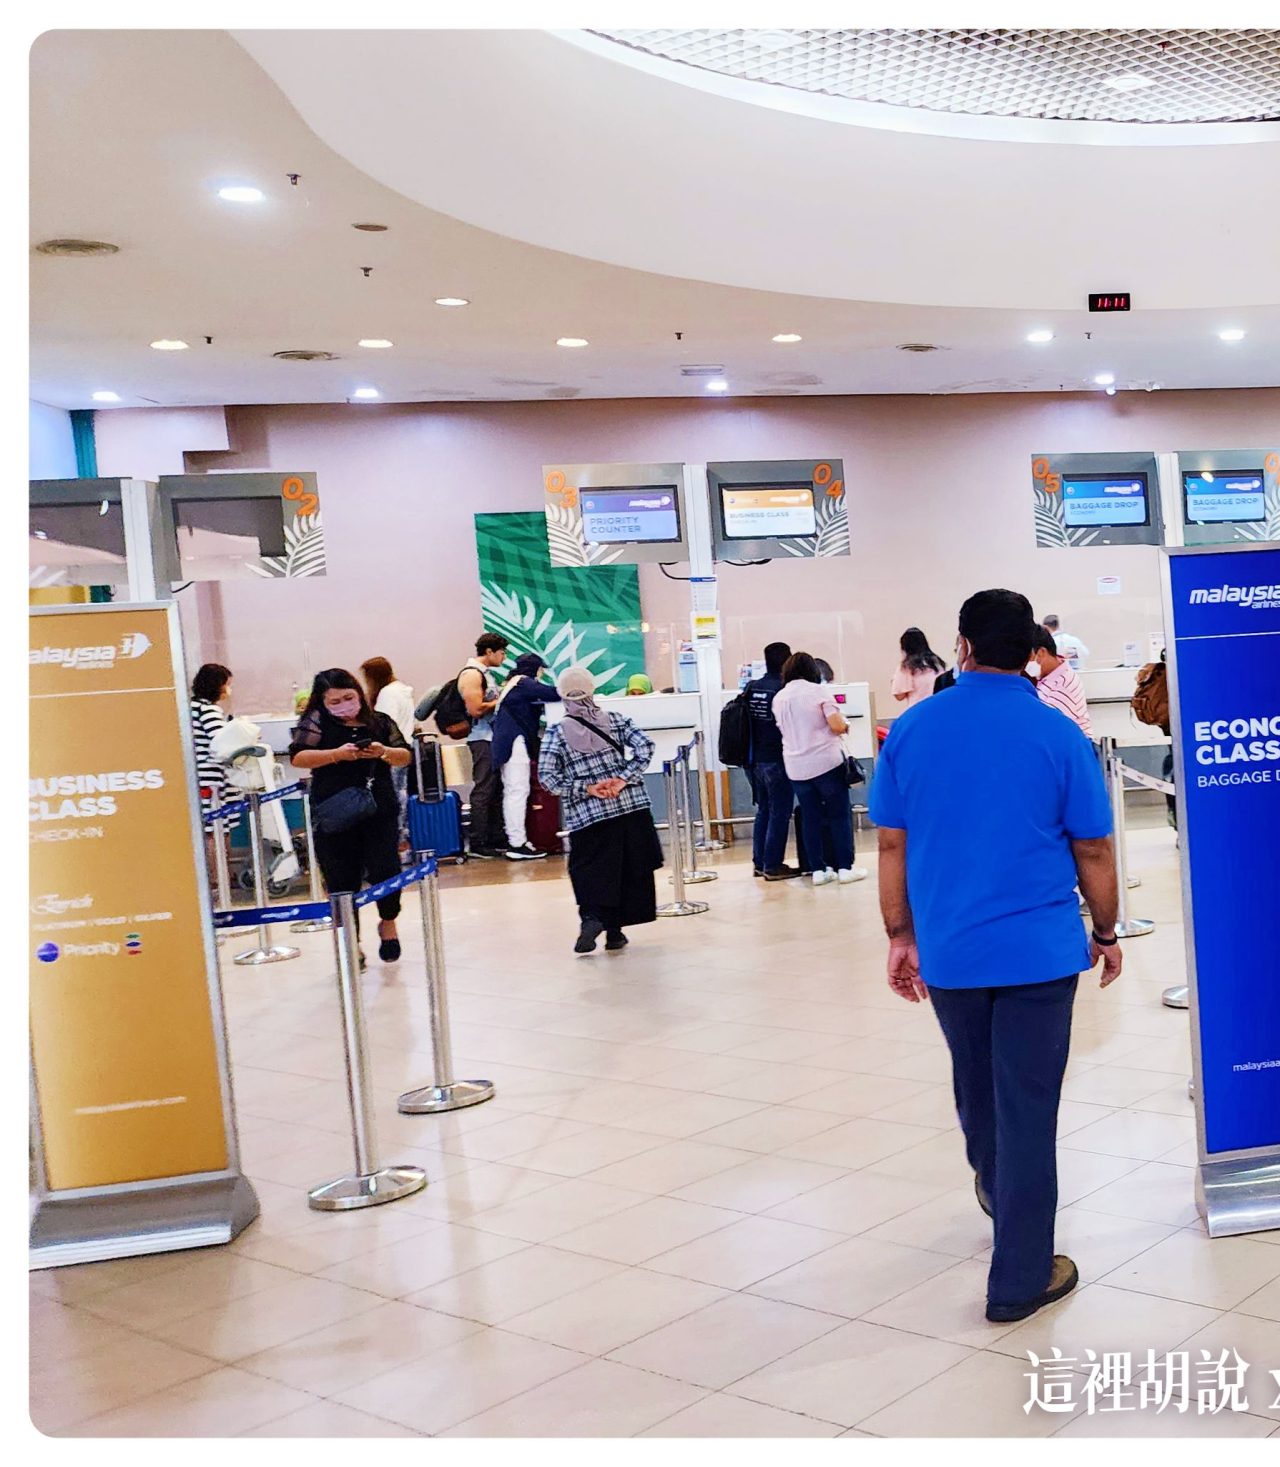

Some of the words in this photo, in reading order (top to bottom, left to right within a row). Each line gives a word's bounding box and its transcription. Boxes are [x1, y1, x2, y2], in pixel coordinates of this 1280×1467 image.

[812, 463, 844, 499] 04
[1032, 458, 1060, 493] 05
[282, 475, 318, 516] 02
[545, 470, 578, 508] 03
[1069, 502, 1112, 510] BAGGAGE
[1114, 501, 1139, 509] DROP
[1193, 498, 1233, 506] BAGGAGE
[590, 516, 640, 525] PRIORITY
[591, 525, 641, 534] COUNTER
[1197, 770, 1272, 788] BAGGAGE
